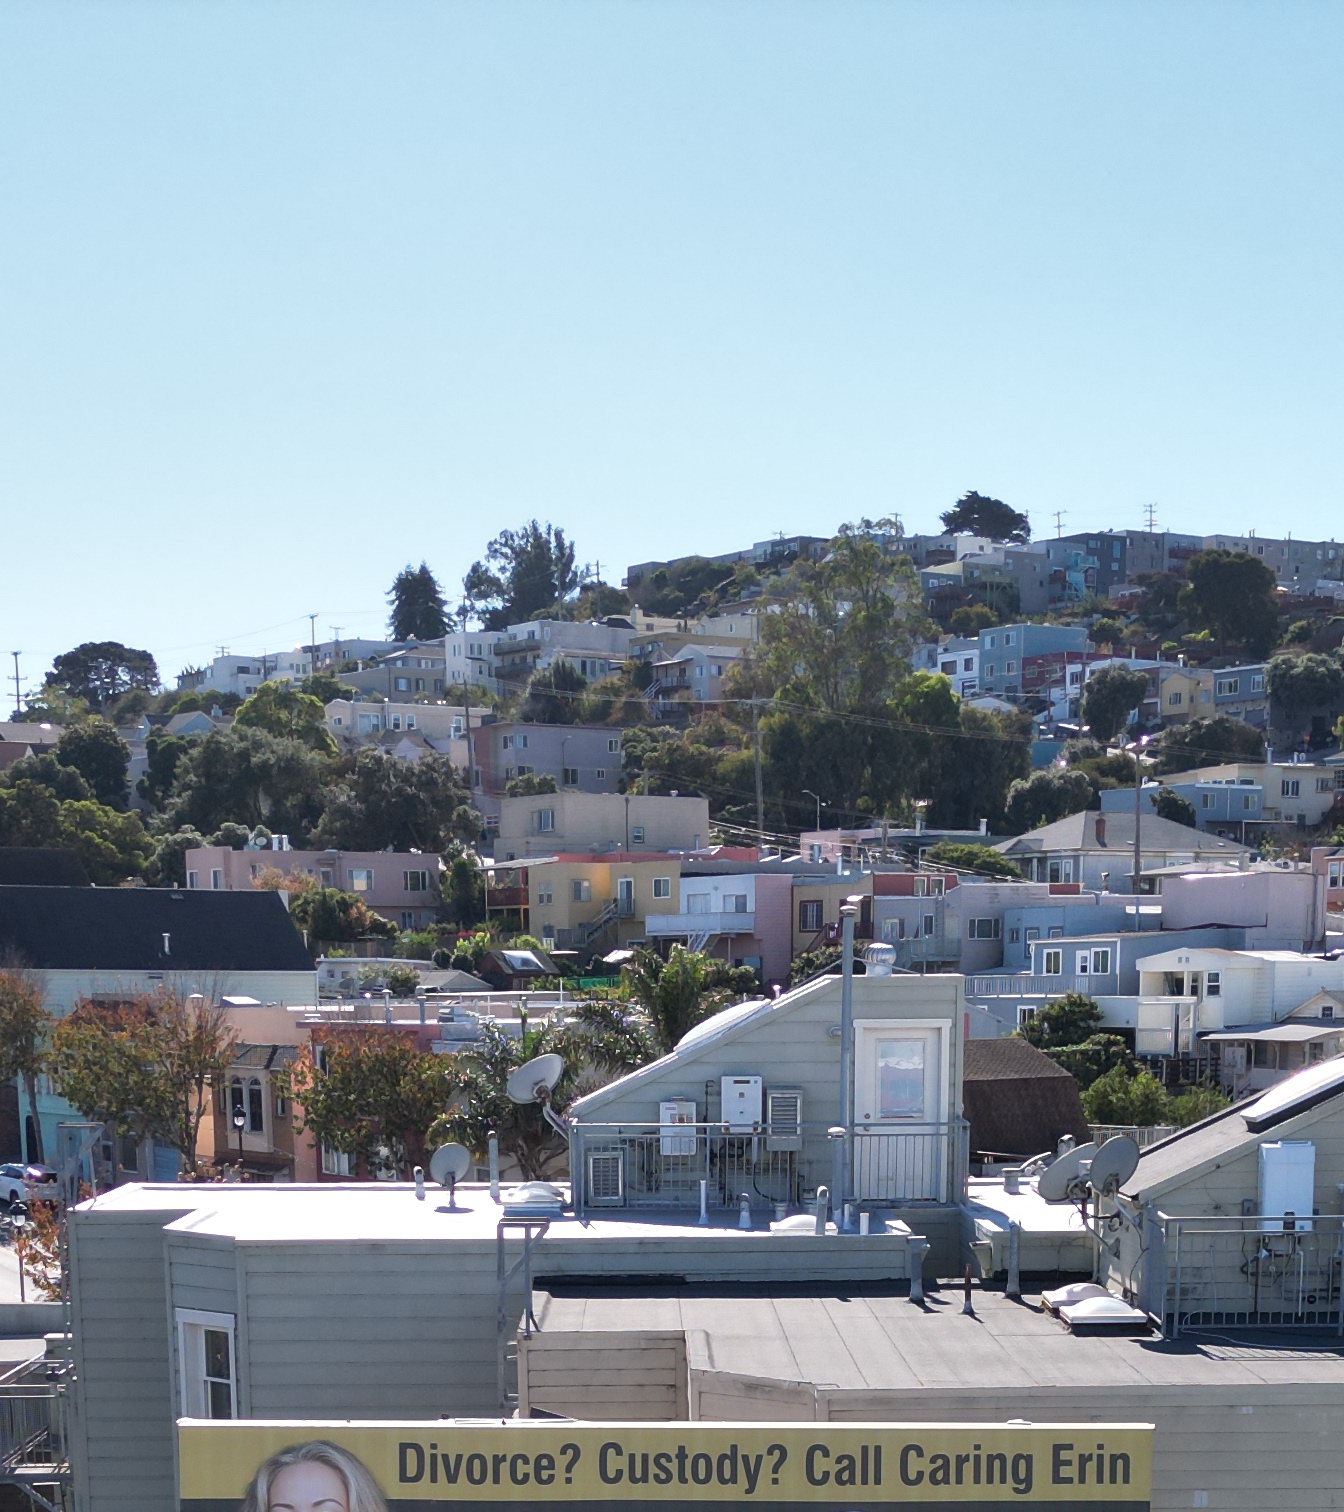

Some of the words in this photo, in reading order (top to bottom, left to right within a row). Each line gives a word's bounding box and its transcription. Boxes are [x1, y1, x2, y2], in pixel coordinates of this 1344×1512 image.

[397, 1441, 582, 1486] Divorce?
[597, 1443, 788, 1494] Custody?
[805, 1445, 882, 1488] Call
[899, 1445, 1035, 1494] Caring
[1052, 1443, 1132, 1486] Erin
